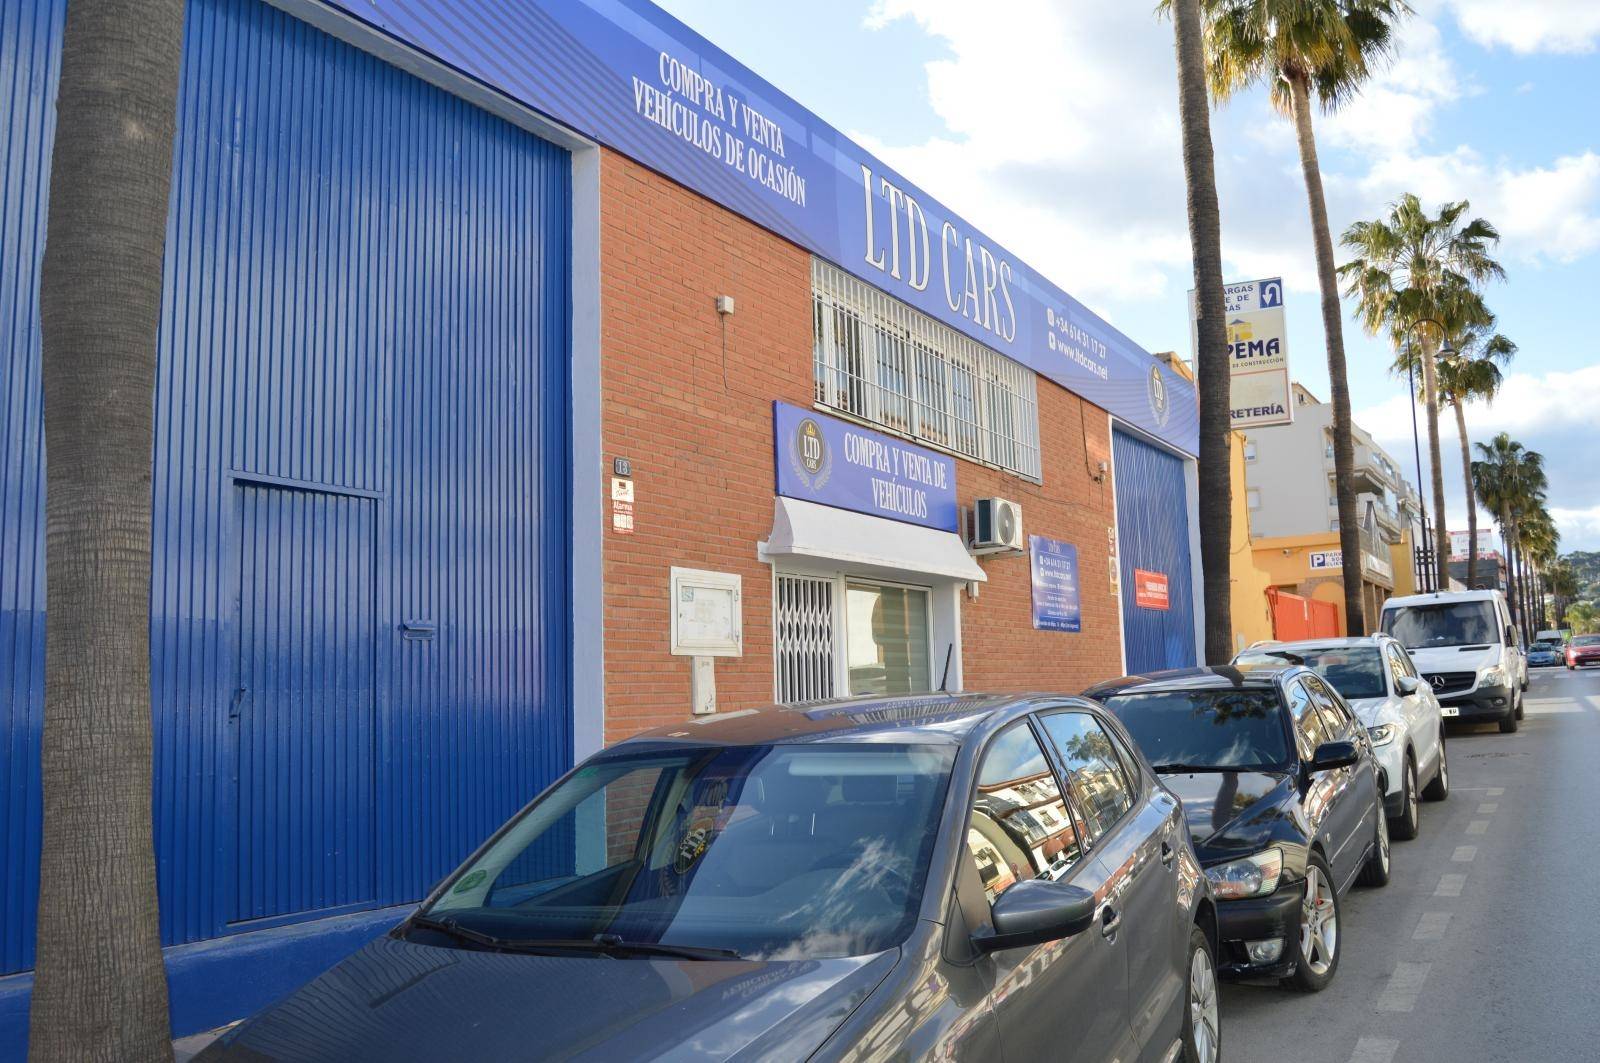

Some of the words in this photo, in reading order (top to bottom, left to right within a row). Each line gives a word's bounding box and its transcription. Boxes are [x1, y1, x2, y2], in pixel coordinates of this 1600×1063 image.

[659, 51, 726, 121] COMPRA
[728, 94, 738, 128] Y
[741, 103, 785, 158] VENTA
[632, 75, 722, 159] VEHÍCULOS
[725, 131, 745, 173] DE
[748, 147, 806, 208] OCASIÓN
[861, 163, 930, 291] LTD
[941, 221, 1016, 343] CARS
[1237, 294, 1249, 302] DE
[1055, 317, 1069, 334] +34
[1229, 403, 1285, 419] RETERÍA
[803, 435, 820, 460] LTD
[806, 457, 818, 470] CARS
[844, 431, 891, 474] COMPRA
[892, 446, 900, 476] Y
[901, 450, 933, 487] VENTA
[934, 461, 947, 490] DE
[871, 477, 927, 519] VEHÍCULOS
